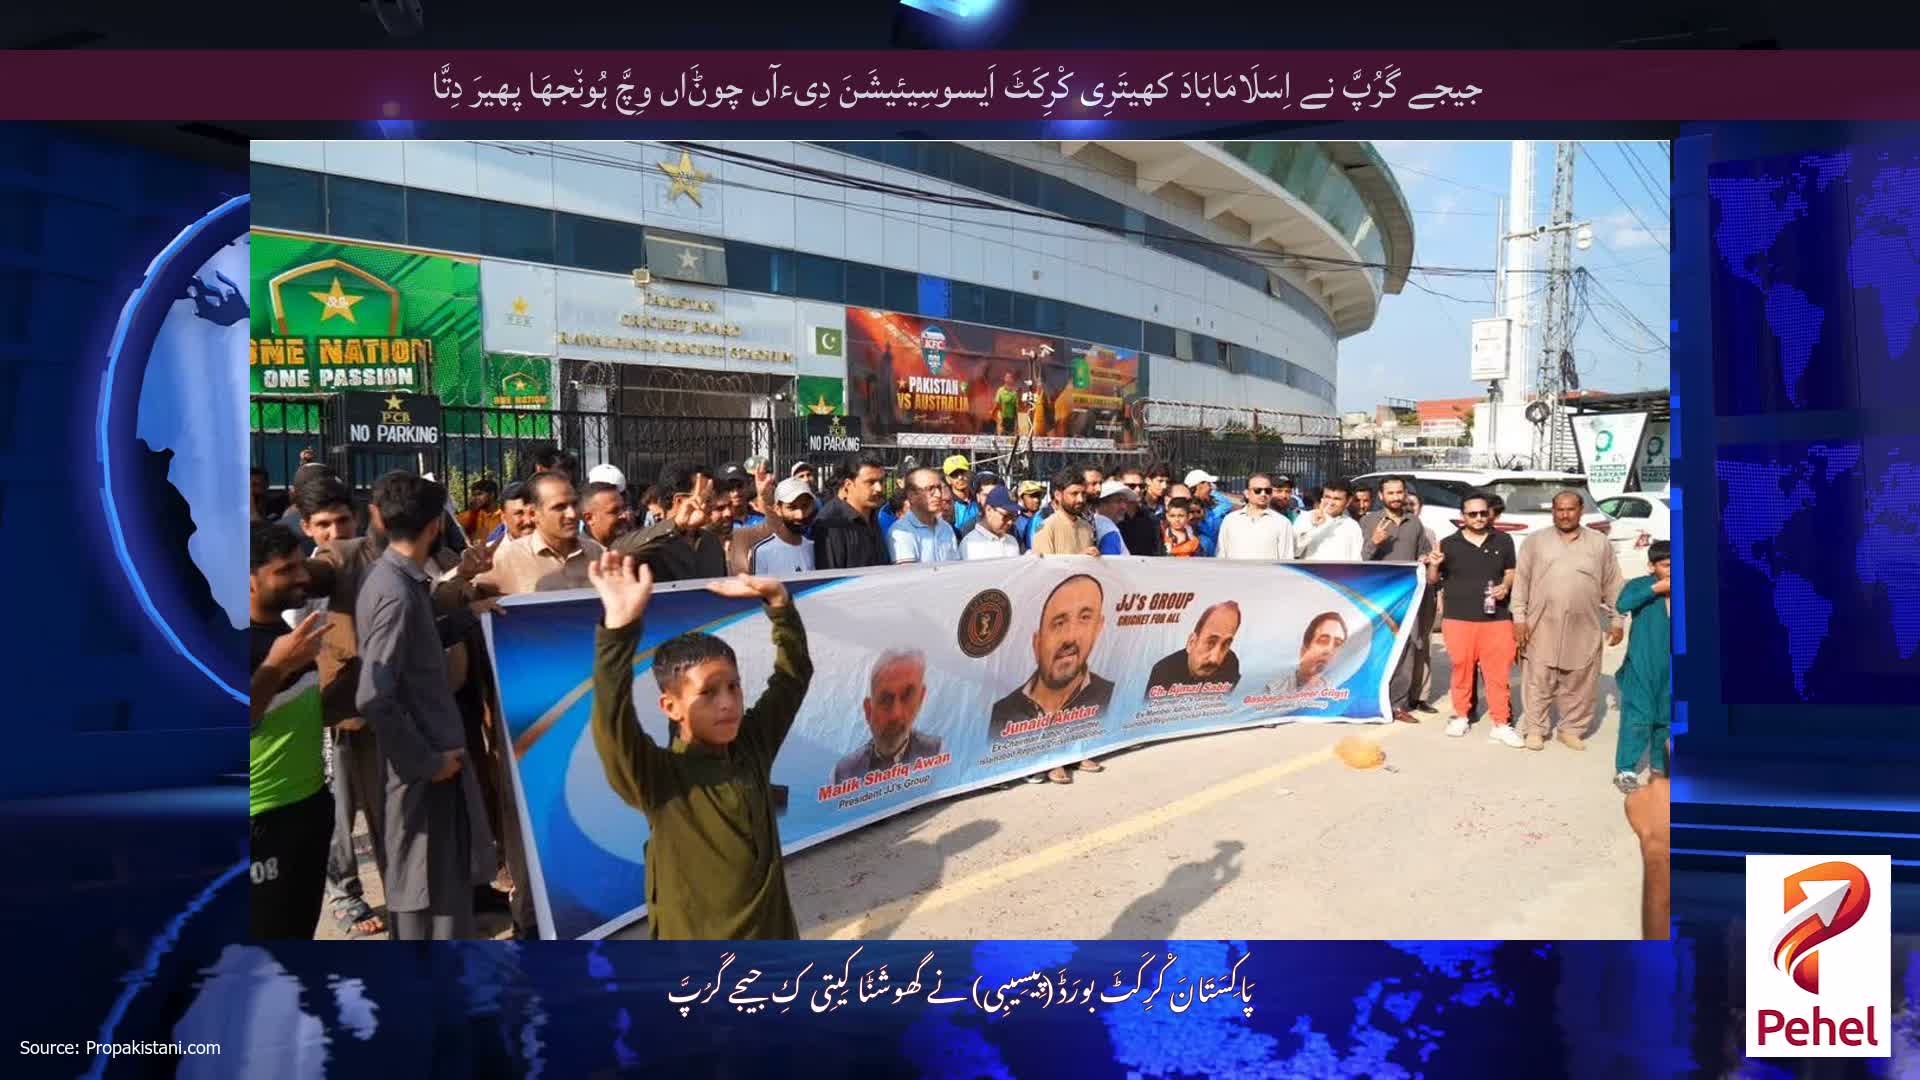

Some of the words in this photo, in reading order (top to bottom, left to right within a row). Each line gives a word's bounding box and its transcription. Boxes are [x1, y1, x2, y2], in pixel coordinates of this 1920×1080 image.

[263, 369, 310, 388] ONE
[320, 368, 414, 388] PASSION
[908, 376, 959, 396] PAKISTAN
[897, 393, 912, 410] VS
[914, 394, 969, 413] AUSTRALIA
[382, 412, 411, 424] PCB
[350, 424, 371, 442] NO
[376, 425, 439, 444] PARKING
[809, 435, 822, 451] NO
[823, 436, 861, 453] PARKING
[1116, 593, 1148, 611] JJ's
[1148, 592, 1195, 611] GROUP
[1149, 613, 1165, 625] FOR
[1166, 612, 1180, 624] ALL
[1000, 711, 1053, 736] Junaid
[1053, 704, 1100, 725] Akhtar
[818, 776, 863, 801] Malik
[863, 762, 911, 787] Shafiq
[912, 752, 952, 773] Awan
[838, 790, 882, 808] President
